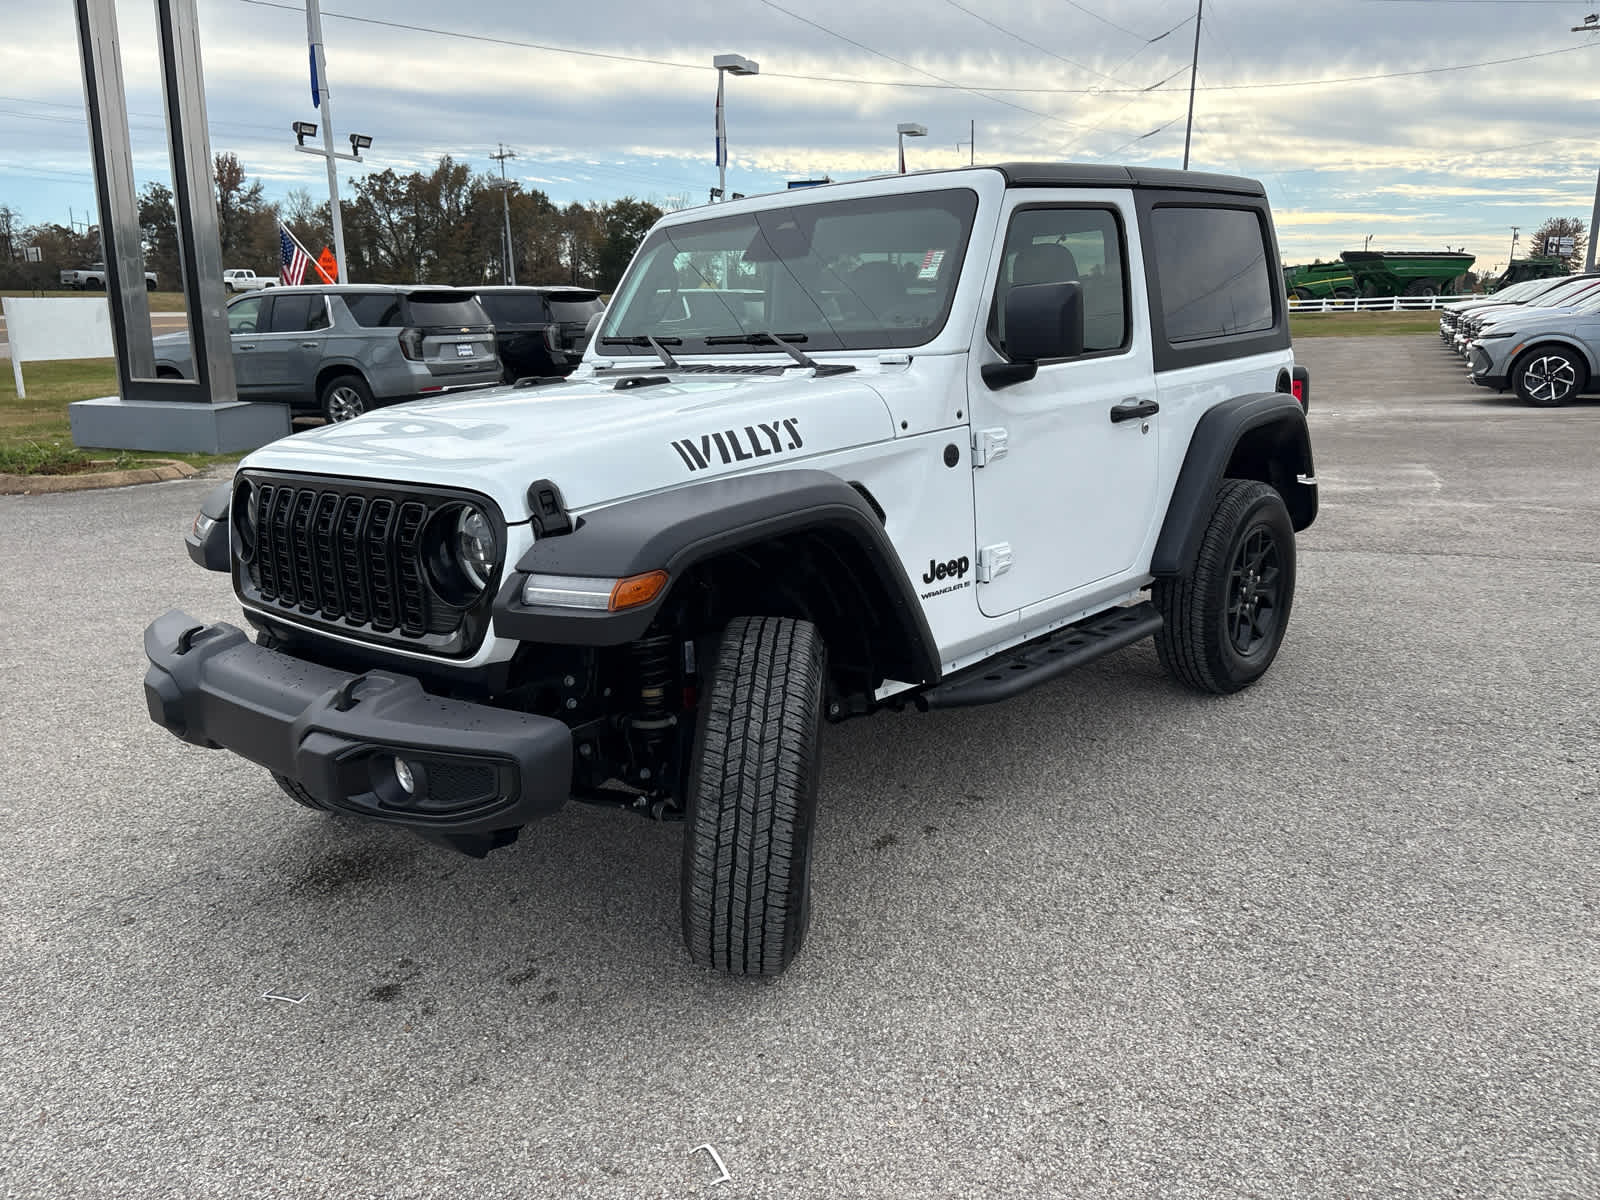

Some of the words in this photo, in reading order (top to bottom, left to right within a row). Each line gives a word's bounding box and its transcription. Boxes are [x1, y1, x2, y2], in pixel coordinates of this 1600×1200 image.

[671, 417, 804, 472] WILLYS
[923, 555, 969, 584] Jeep
[920, 583, 963, 600] WRANGLER
